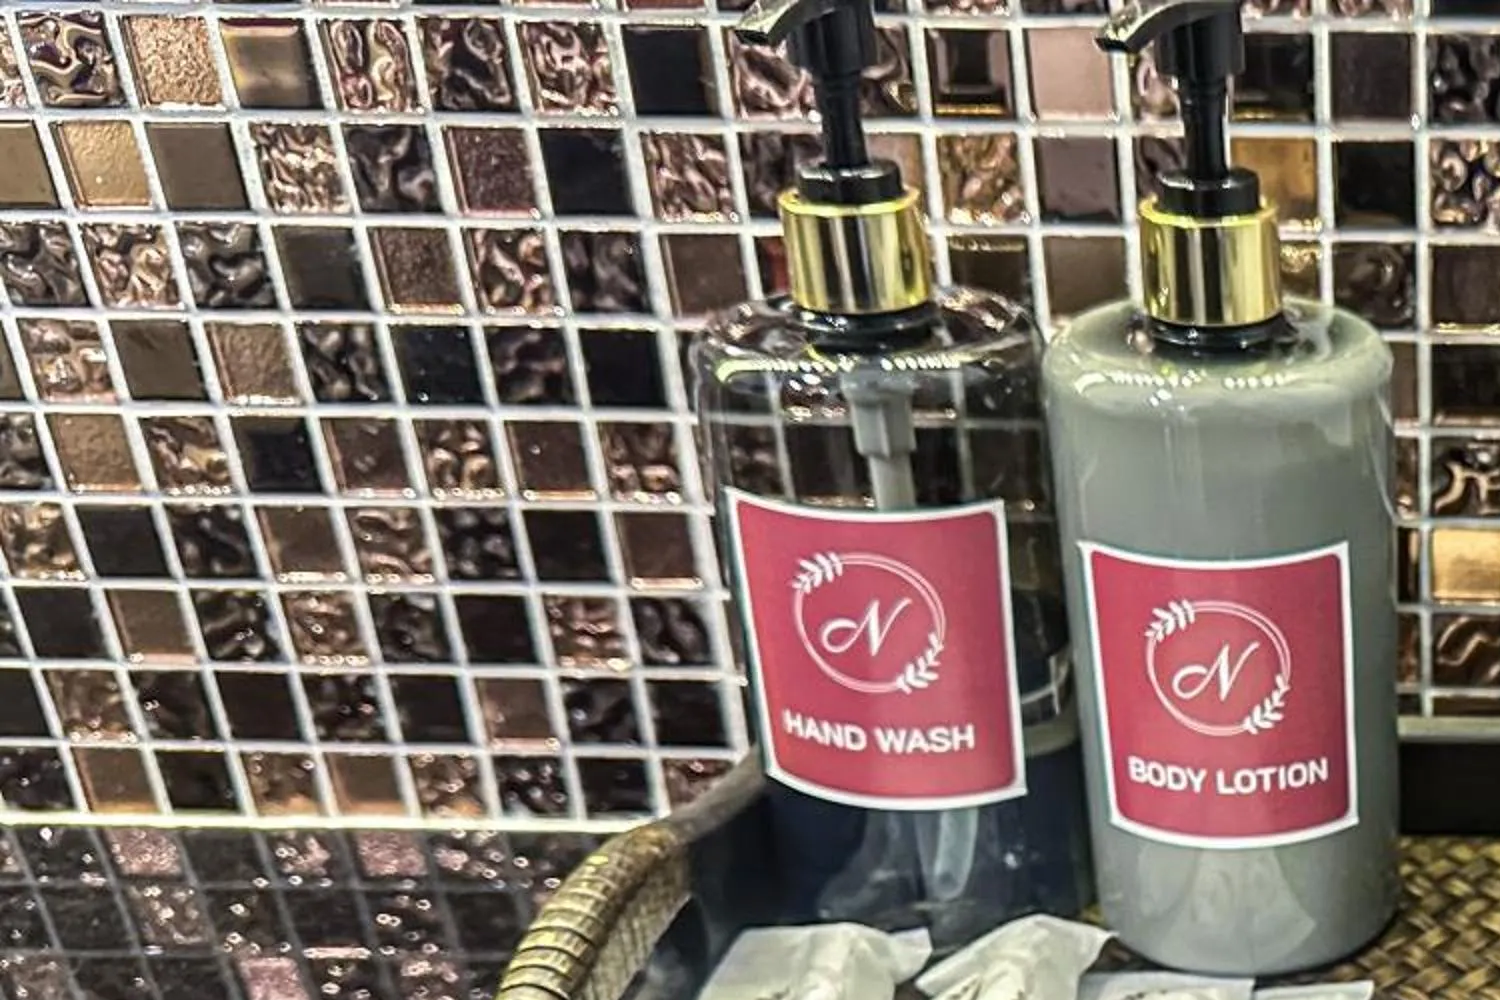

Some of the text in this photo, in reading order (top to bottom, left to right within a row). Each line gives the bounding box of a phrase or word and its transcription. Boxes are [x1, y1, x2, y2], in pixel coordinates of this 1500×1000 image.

[821, 598, 912, 656] N
[1172, 641, 1260, 701] N
[783, 709, 975, 754] HAND WASH
[1128, 755, 1328, 795] BODY LOTION
